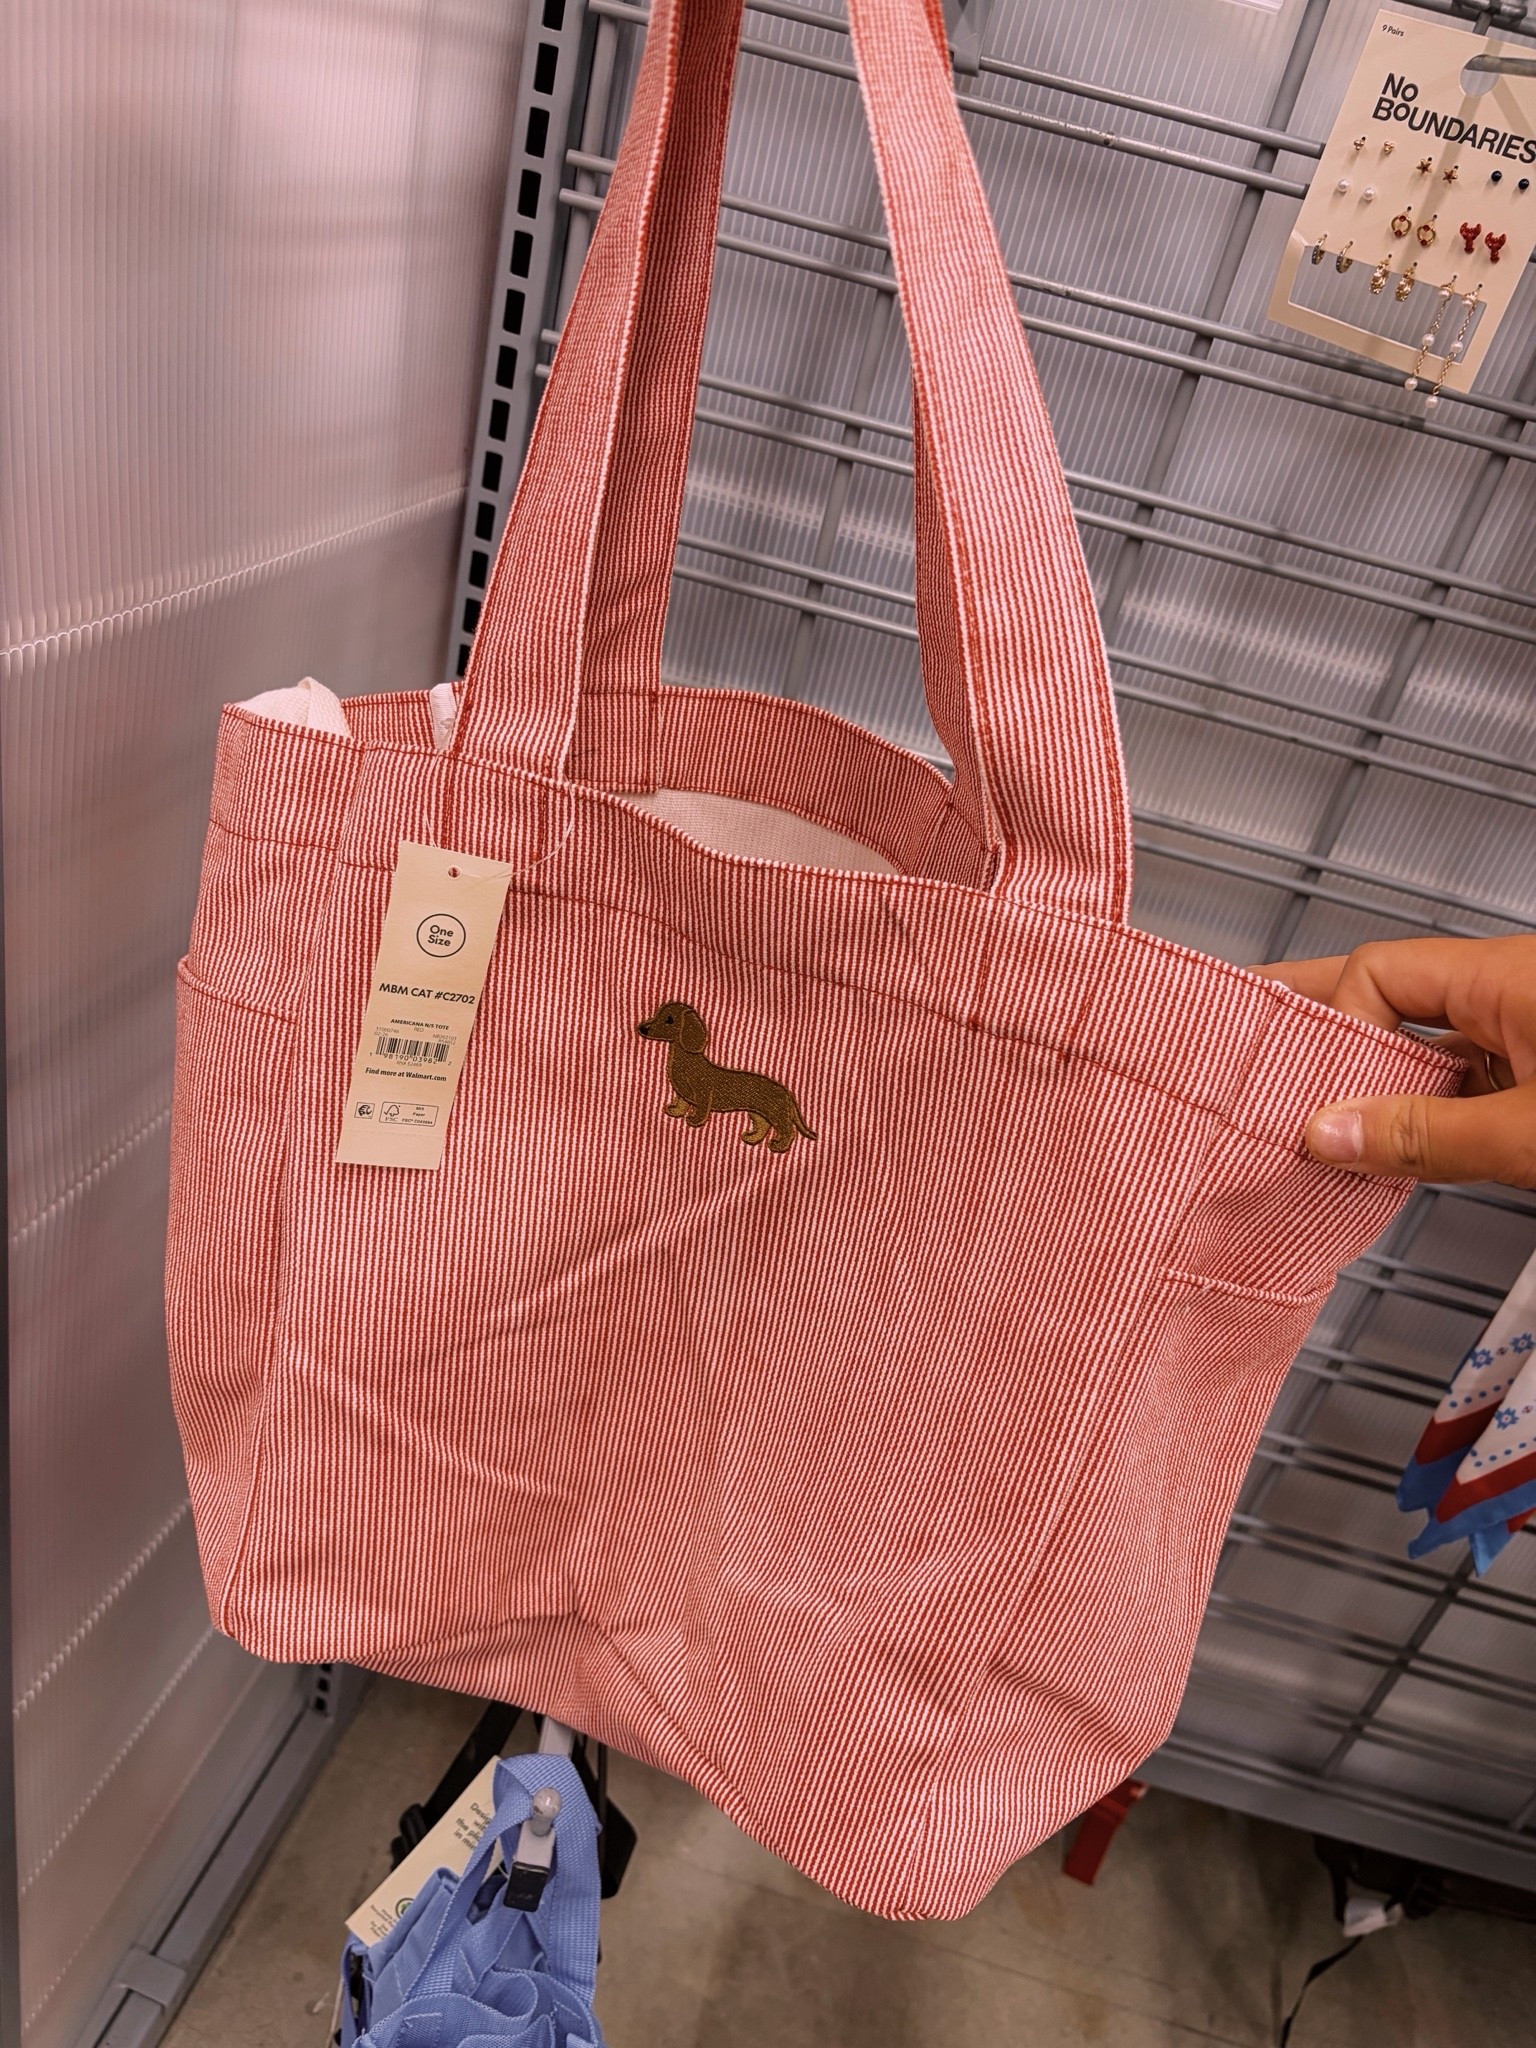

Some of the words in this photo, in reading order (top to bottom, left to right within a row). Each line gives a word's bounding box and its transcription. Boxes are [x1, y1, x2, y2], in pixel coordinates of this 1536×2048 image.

[1382, 24, 1388, 32] 9
[1388, 26, 1405, 37] Pairs
[430, 924, 454, 937] One
[427, 934, 451, 947] Size
[379, 982, 408, 996] MBM
[411, 987, 433, 998] CAT
[434, 991, 476, 1005] #C2702
[390, 1018, 424, 1028] AMERICANA
[435, 1023, 450, 1031] TOTE
[365, 1067, 380, 1075] Find
[405, 1072, 447, 1082] Walmart.com
